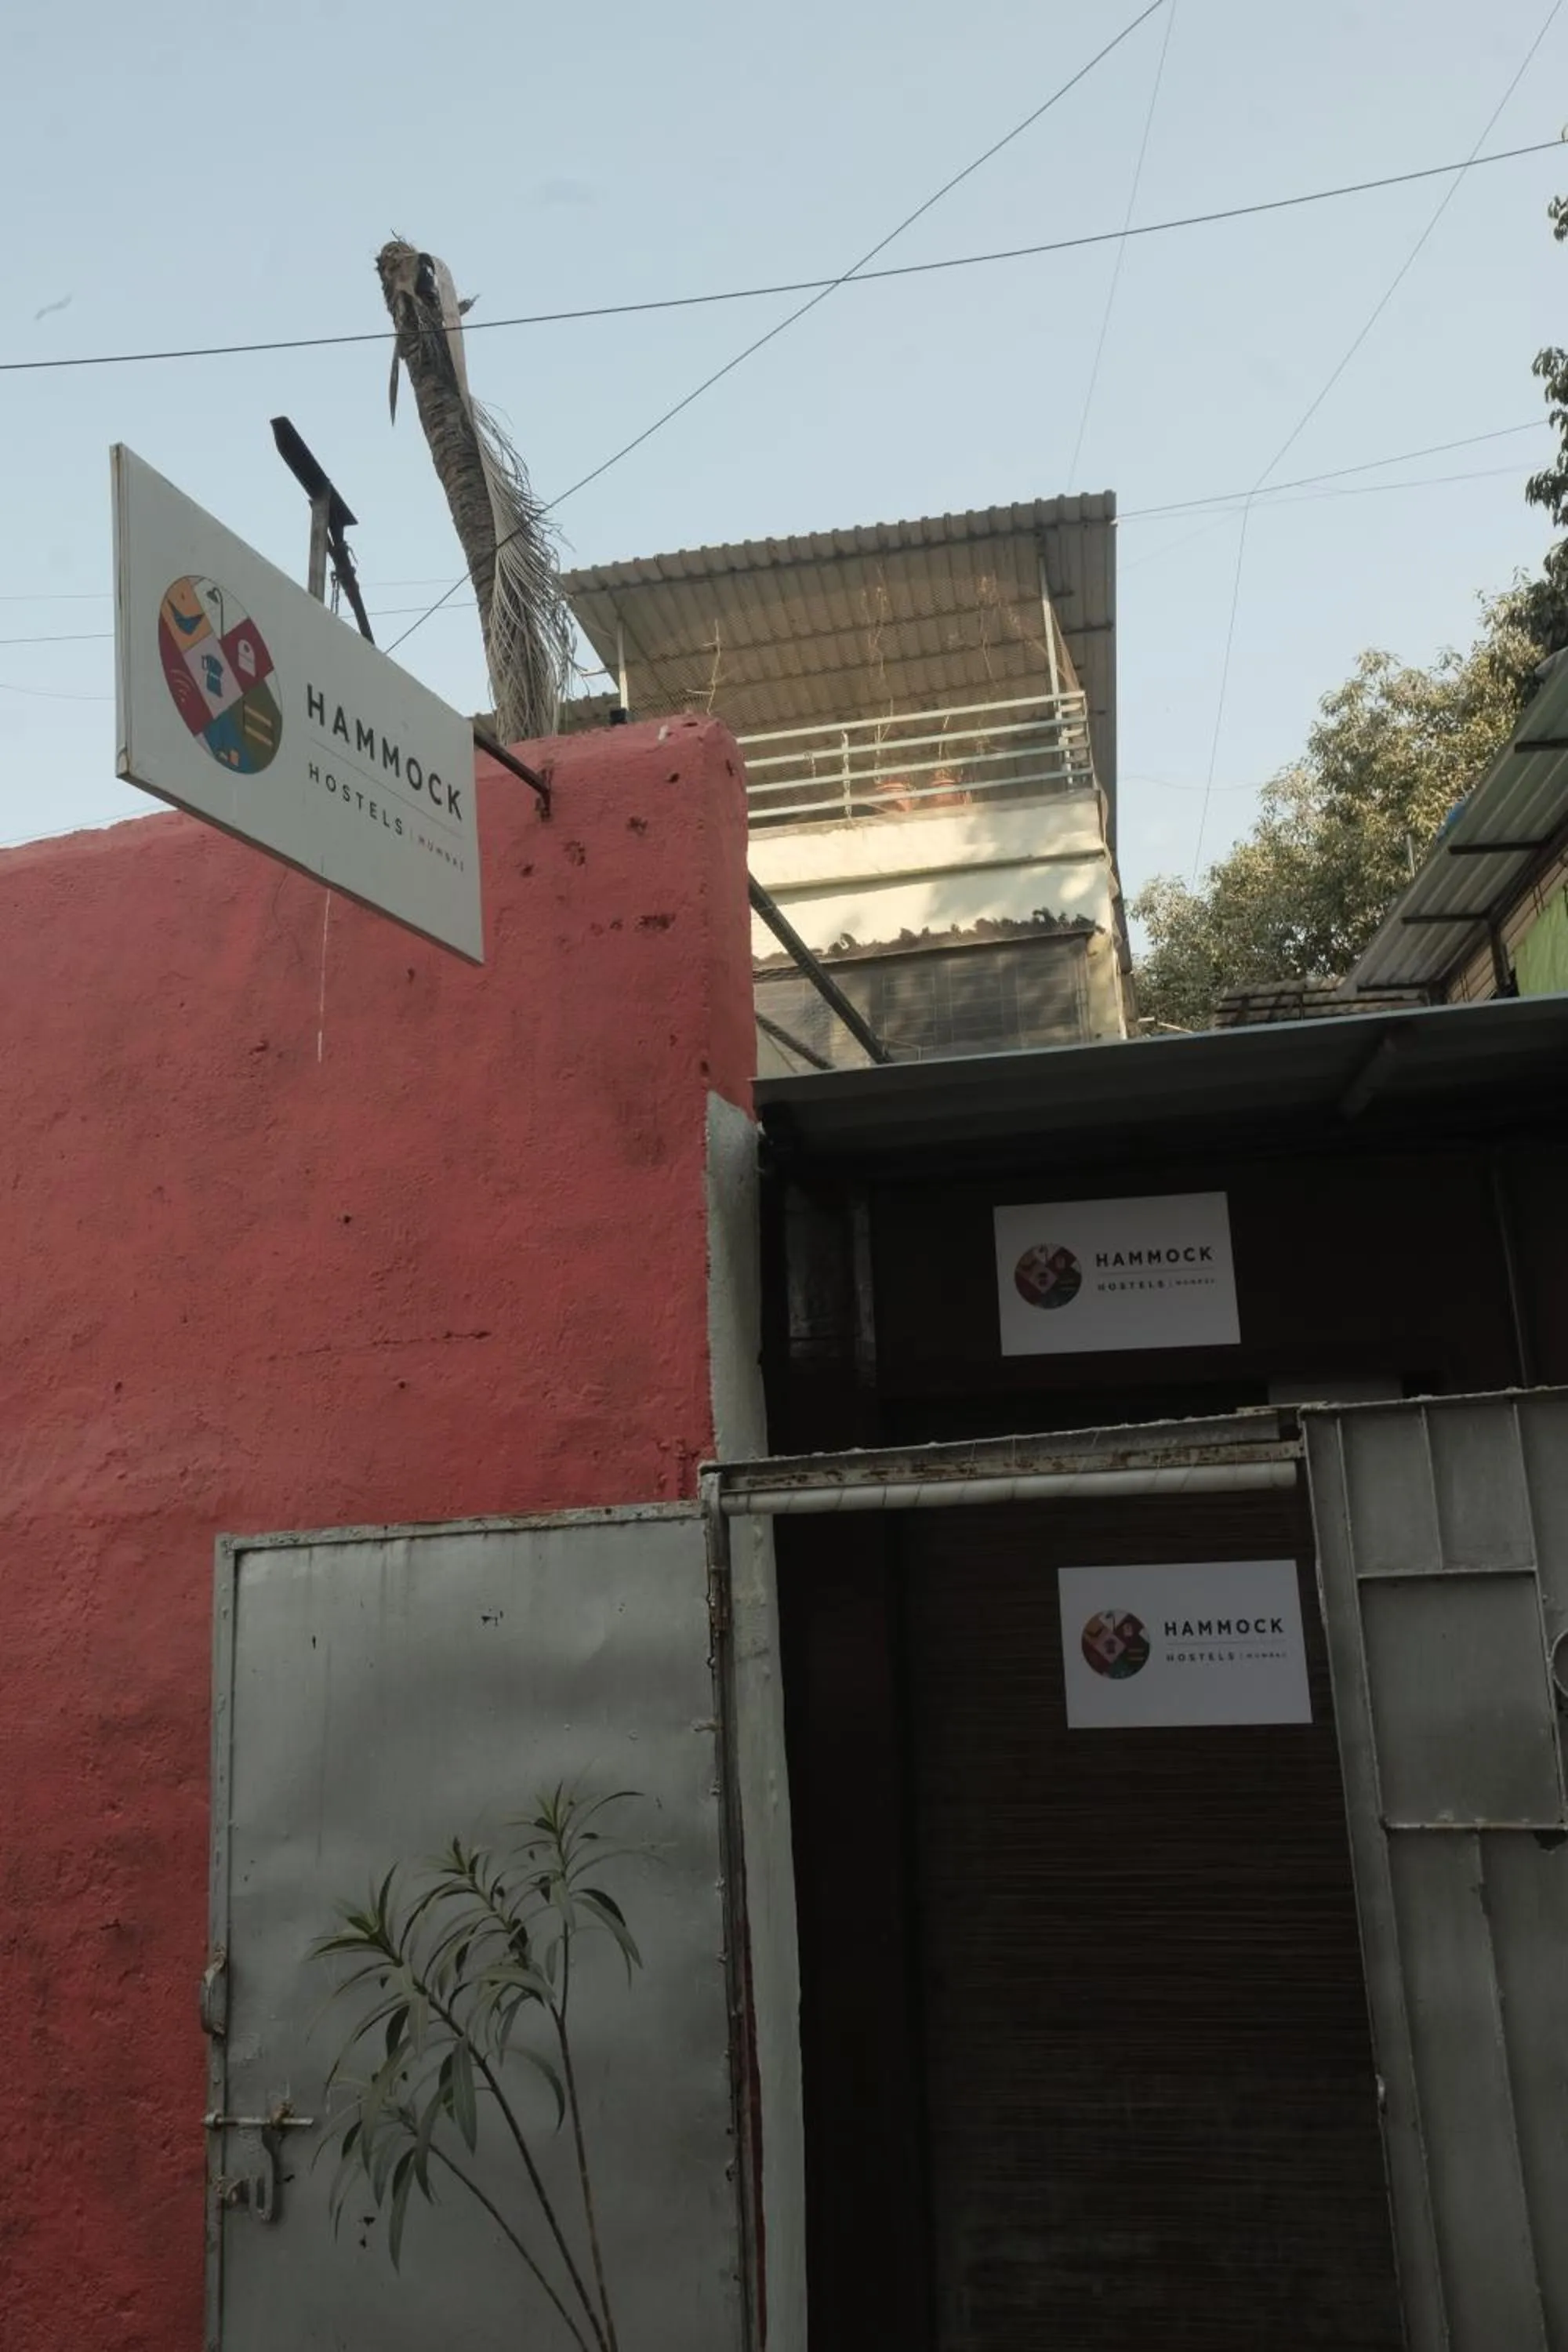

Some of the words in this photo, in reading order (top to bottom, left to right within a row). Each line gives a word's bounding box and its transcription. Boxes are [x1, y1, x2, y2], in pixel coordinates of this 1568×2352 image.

[306, 682, 463, 821] HAMMOCK
[309, 762, 403, 836] HOSTELS
[1095, 1245, 1214, 1268] HAMMOCK
[1098, 1279, 1164, 1291] HOSTELS
[1163, 1617, 1284, 1637] HAMMOCK
[1166, 1651, 1235, 1662] HOSTELS
